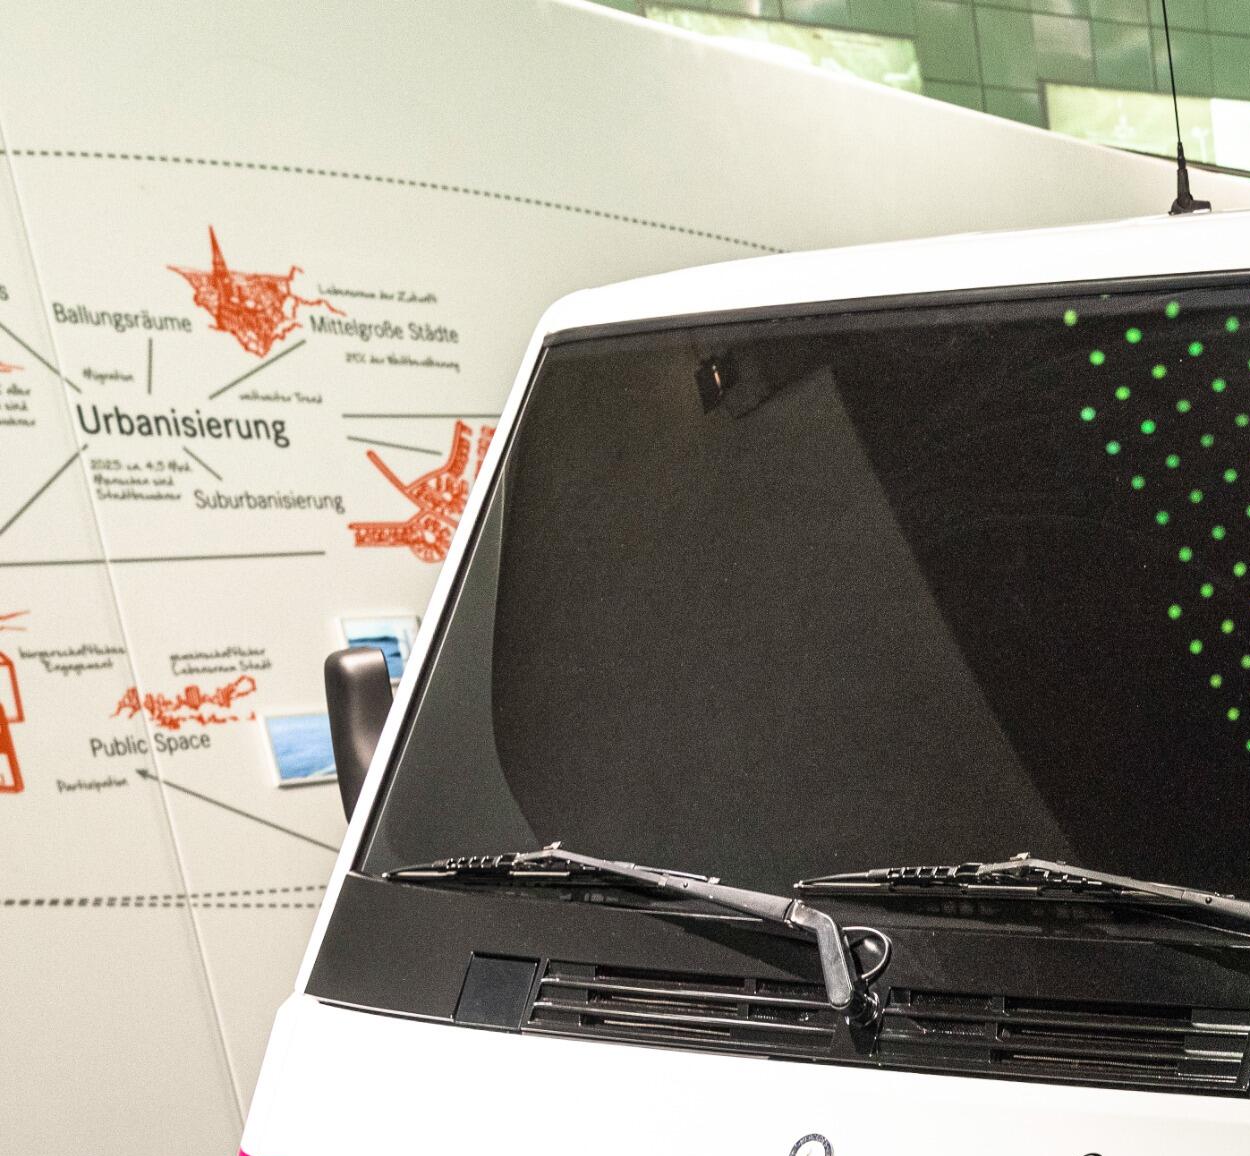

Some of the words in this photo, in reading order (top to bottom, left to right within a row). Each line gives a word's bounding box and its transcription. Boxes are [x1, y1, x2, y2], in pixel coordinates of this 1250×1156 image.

[52, 302, 193, 334] Ballungsräume
[309, 315, 405, 342] Mittelgroße
[407, 321, 460, 345] Städte
[77, 403, 291, 449] Urbanisierung
[194, 489, 345, 514] Suburbanisierung
[89, 735, 149, 758] Public
[153, 732, 212, 756] Space
